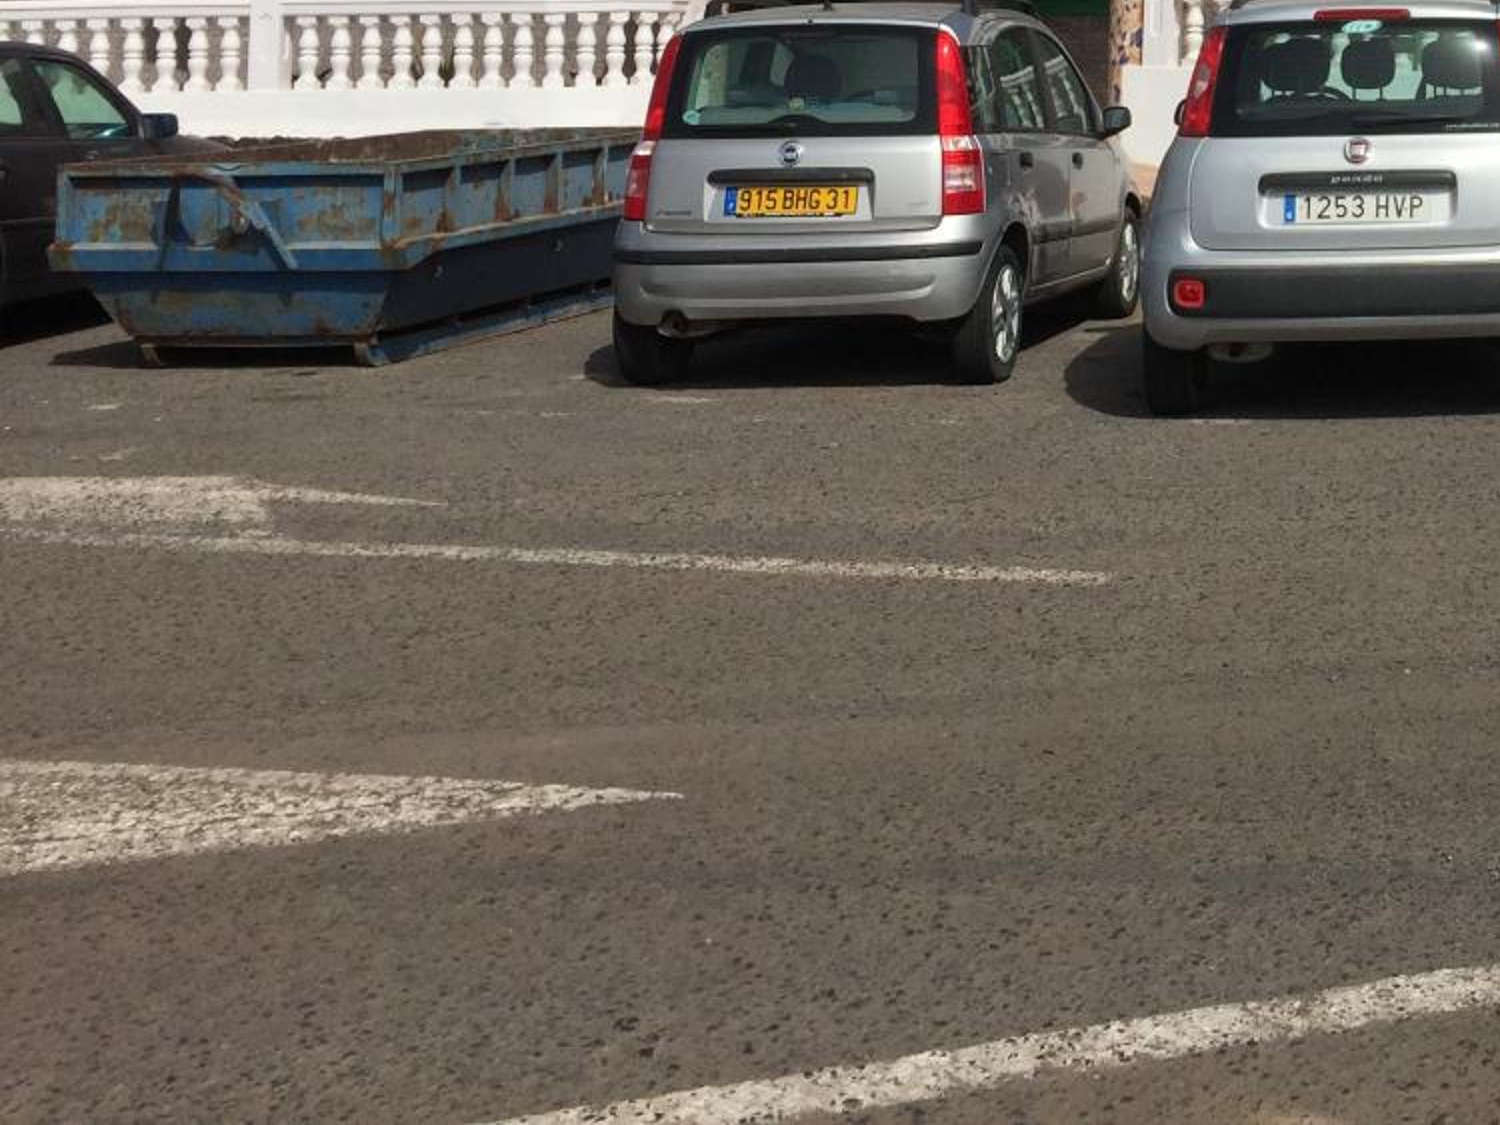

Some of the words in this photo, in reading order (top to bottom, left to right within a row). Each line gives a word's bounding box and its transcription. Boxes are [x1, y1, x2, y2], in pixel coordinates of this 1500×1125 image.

[739, 188, 777, 211] 915
[781, 188, 821, 210] BHG
[825, 188, 850, 210] 31
[1303, 194, 1366, 220] 1253
[1375, 194, 1424, 219] HVP
